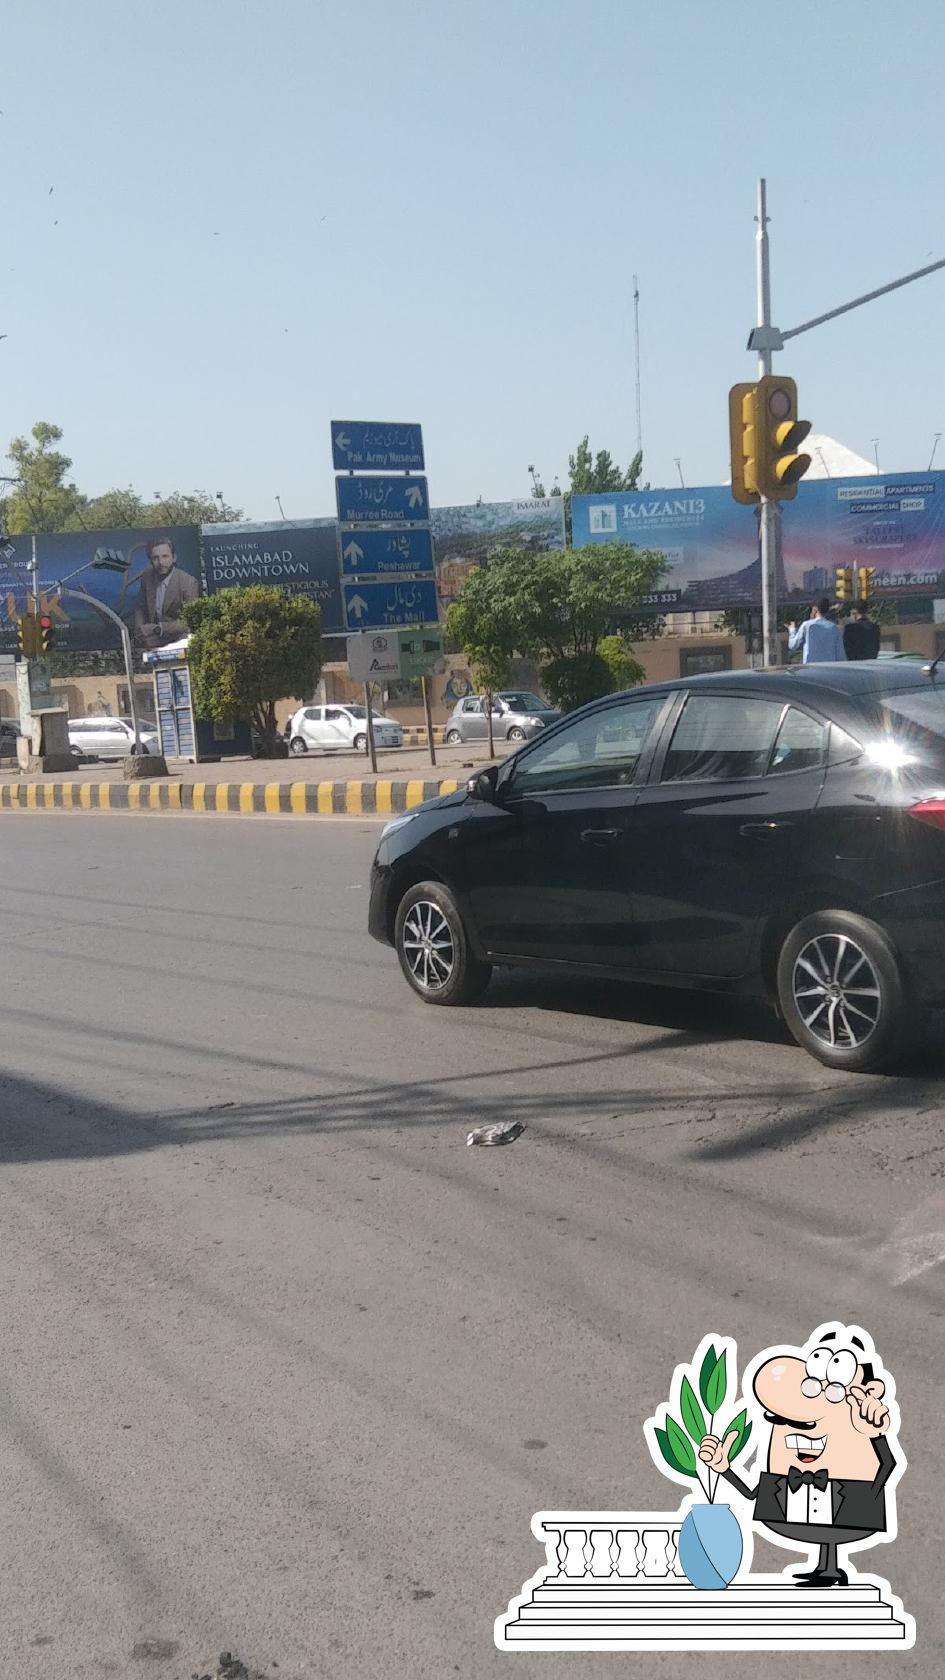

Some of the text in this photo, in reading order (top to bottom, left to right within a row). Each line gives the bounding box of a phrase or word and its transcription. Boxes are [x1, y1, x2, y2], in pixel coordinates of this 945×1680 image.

[347, 452, 421, 464] Pak Army Museum
[517, 500, 551, 511] IMARAT
[851, 502, 900, 512] COMMERCIAL
[347, 508, 405, 520] Murree Road
[210, 543, 259, 552] LAUNCHING
[386, 535, 411, 559] پشاور
[212, 551, 293, 568] ISLAMABAD
[213, 562, 310, 581] DOWNTOWN
[377, 560, 421, 572] Peshawar
[386, 583, 422, 612] دی مال
[383, 611, 425, 624] The Mall
